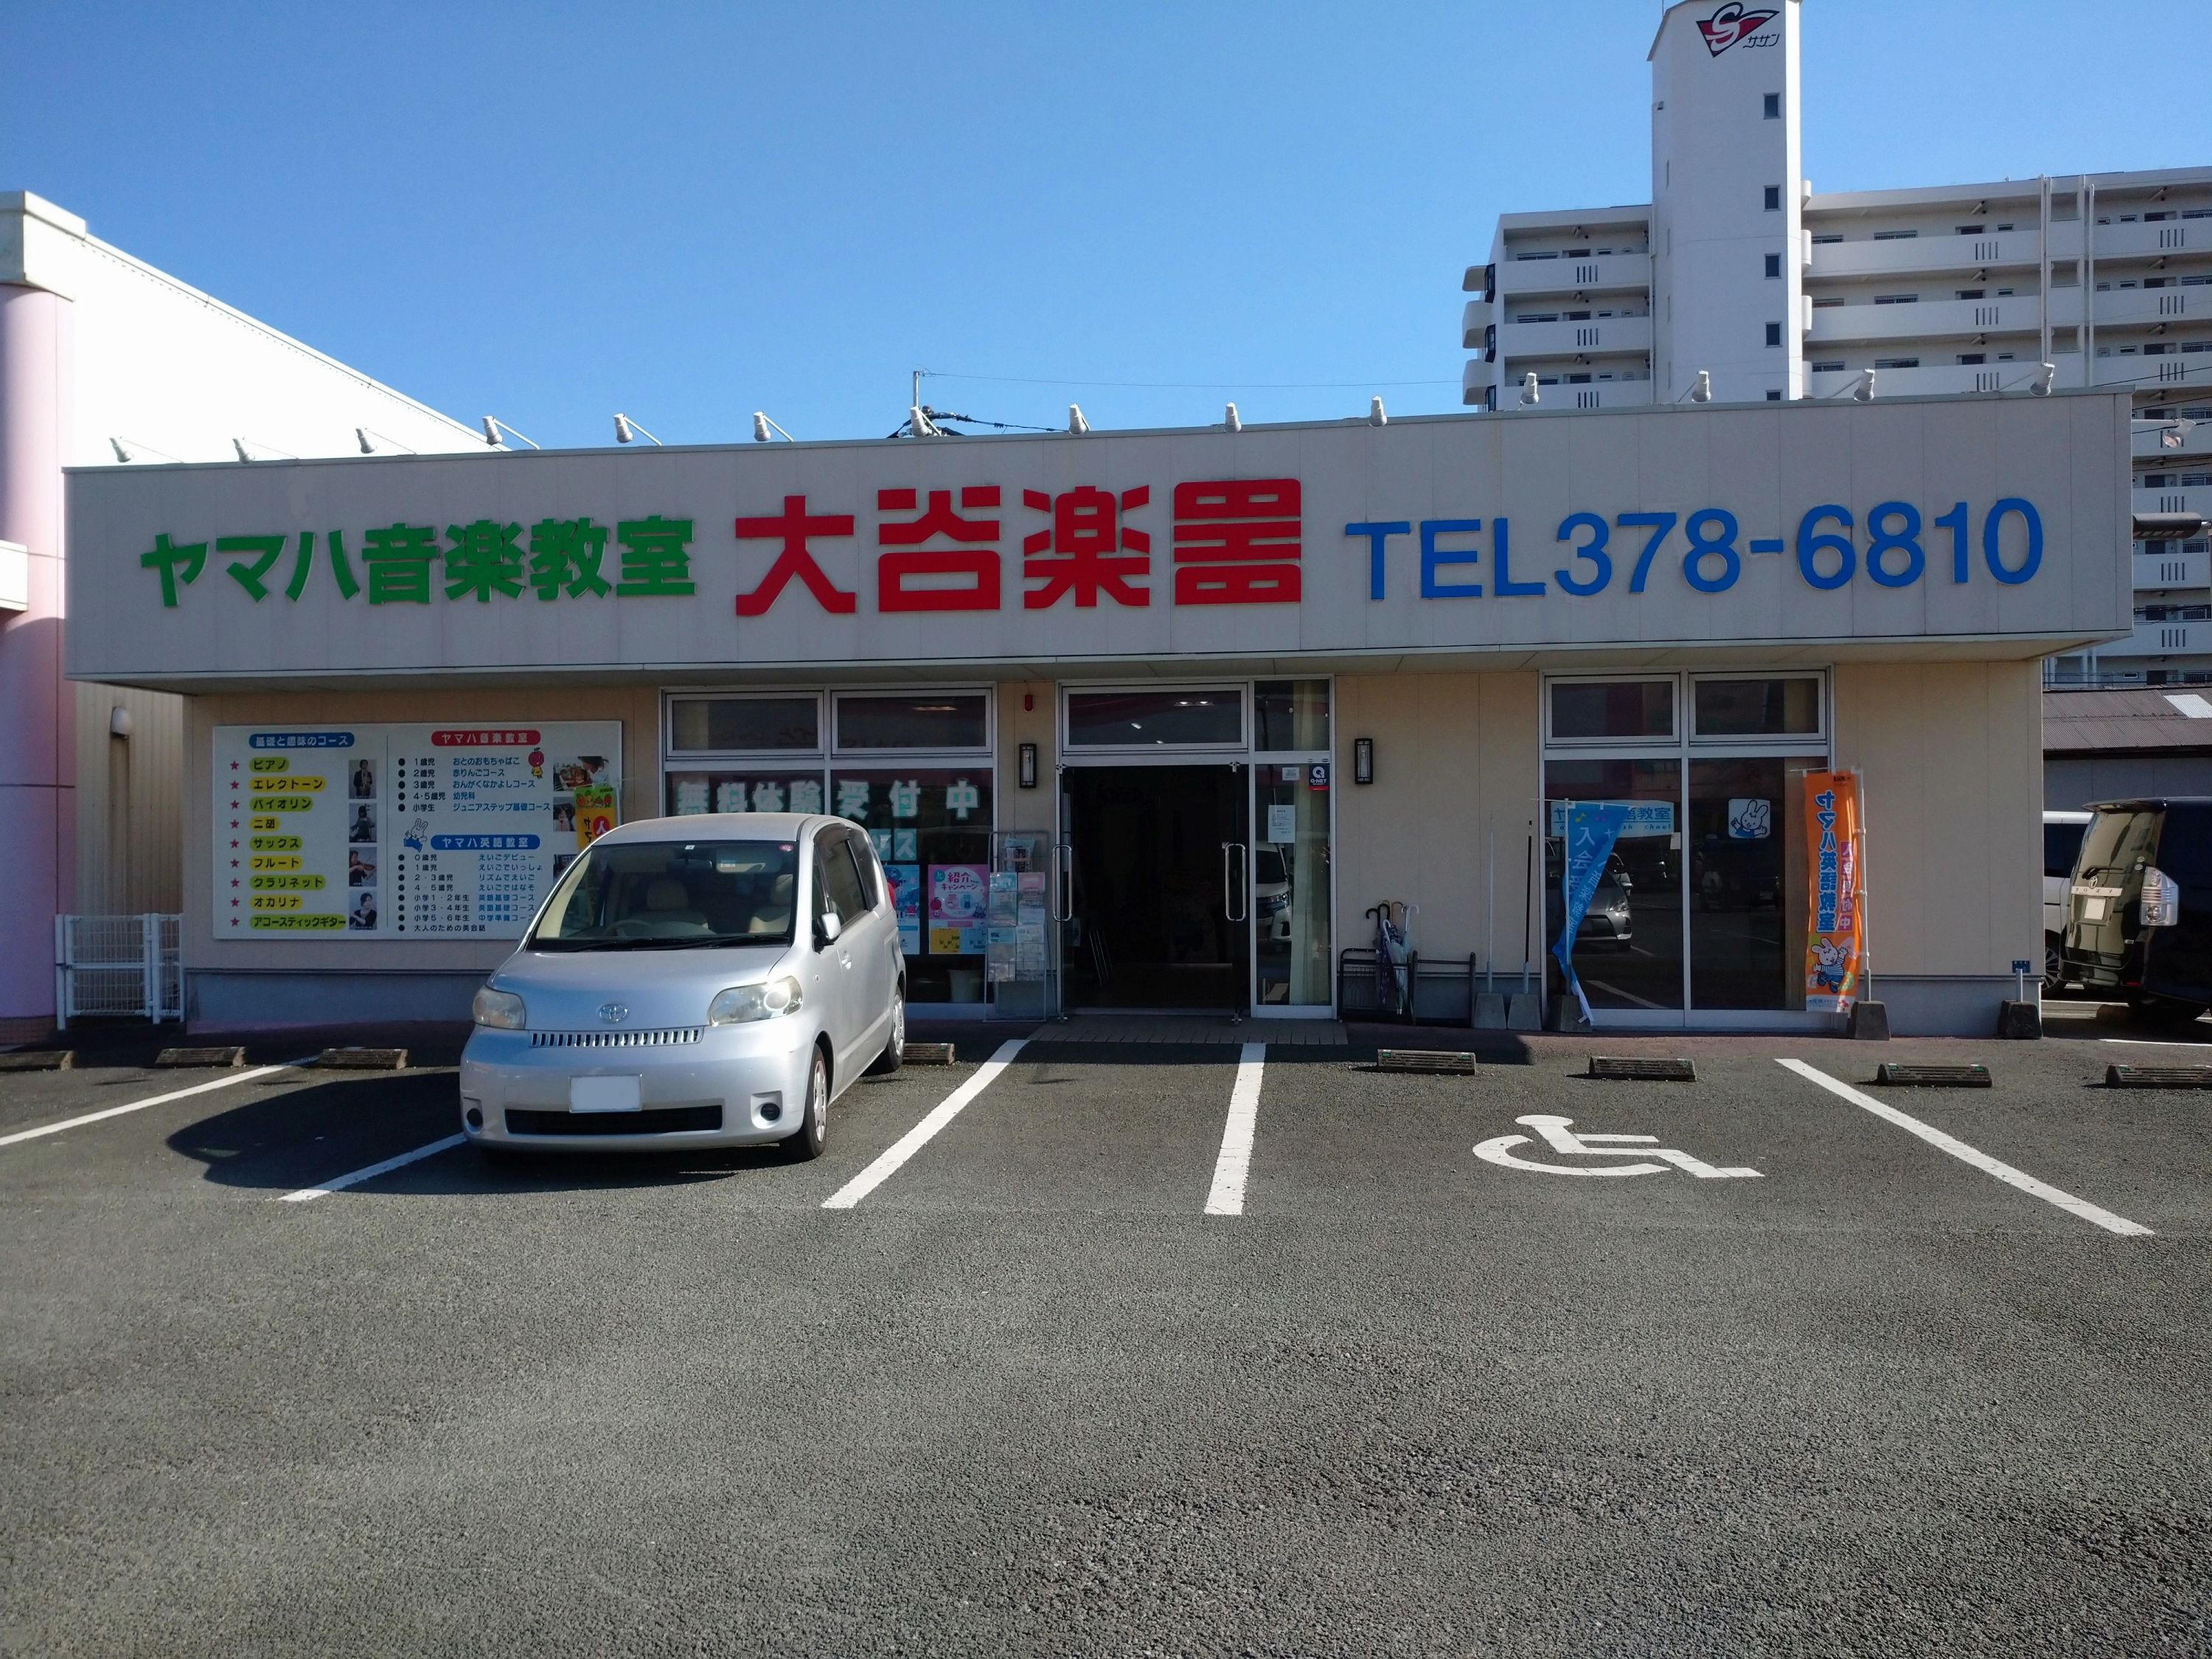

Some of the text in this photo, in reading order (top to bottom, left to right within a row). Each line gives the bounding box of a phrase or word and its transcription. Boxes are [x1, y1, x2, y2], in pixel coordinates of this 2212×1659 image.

[734, 478, 1302, 616] 大谷楽器
[139, 514, 696, 608] ヤマハ音楽教室
[255, 735, 349, 746] 基礎と趣味のコース
[442, 732, 528, 744] ヤマハ音楽教室
[254, 760, 286, 770] ピアノ
[254, 779, 323, 790] エレクトーン
[453, 792, 476, 800] 幼児科
[254, 799, 311, 810] バイオリン
[413, 804, 435, 812] 小学生
[254, 818, 275, 829] 二胡
[254, 838, 299, 849] サックス
[442, 837, 529, 848] ヤマハ英語教室
[254, 858, 299, 868] フルート
[254, 877, 323, 888] クラリネット
[254, 897, 299, 908] オカリナ
[254, 917, 347, 927] アコースティックギター
